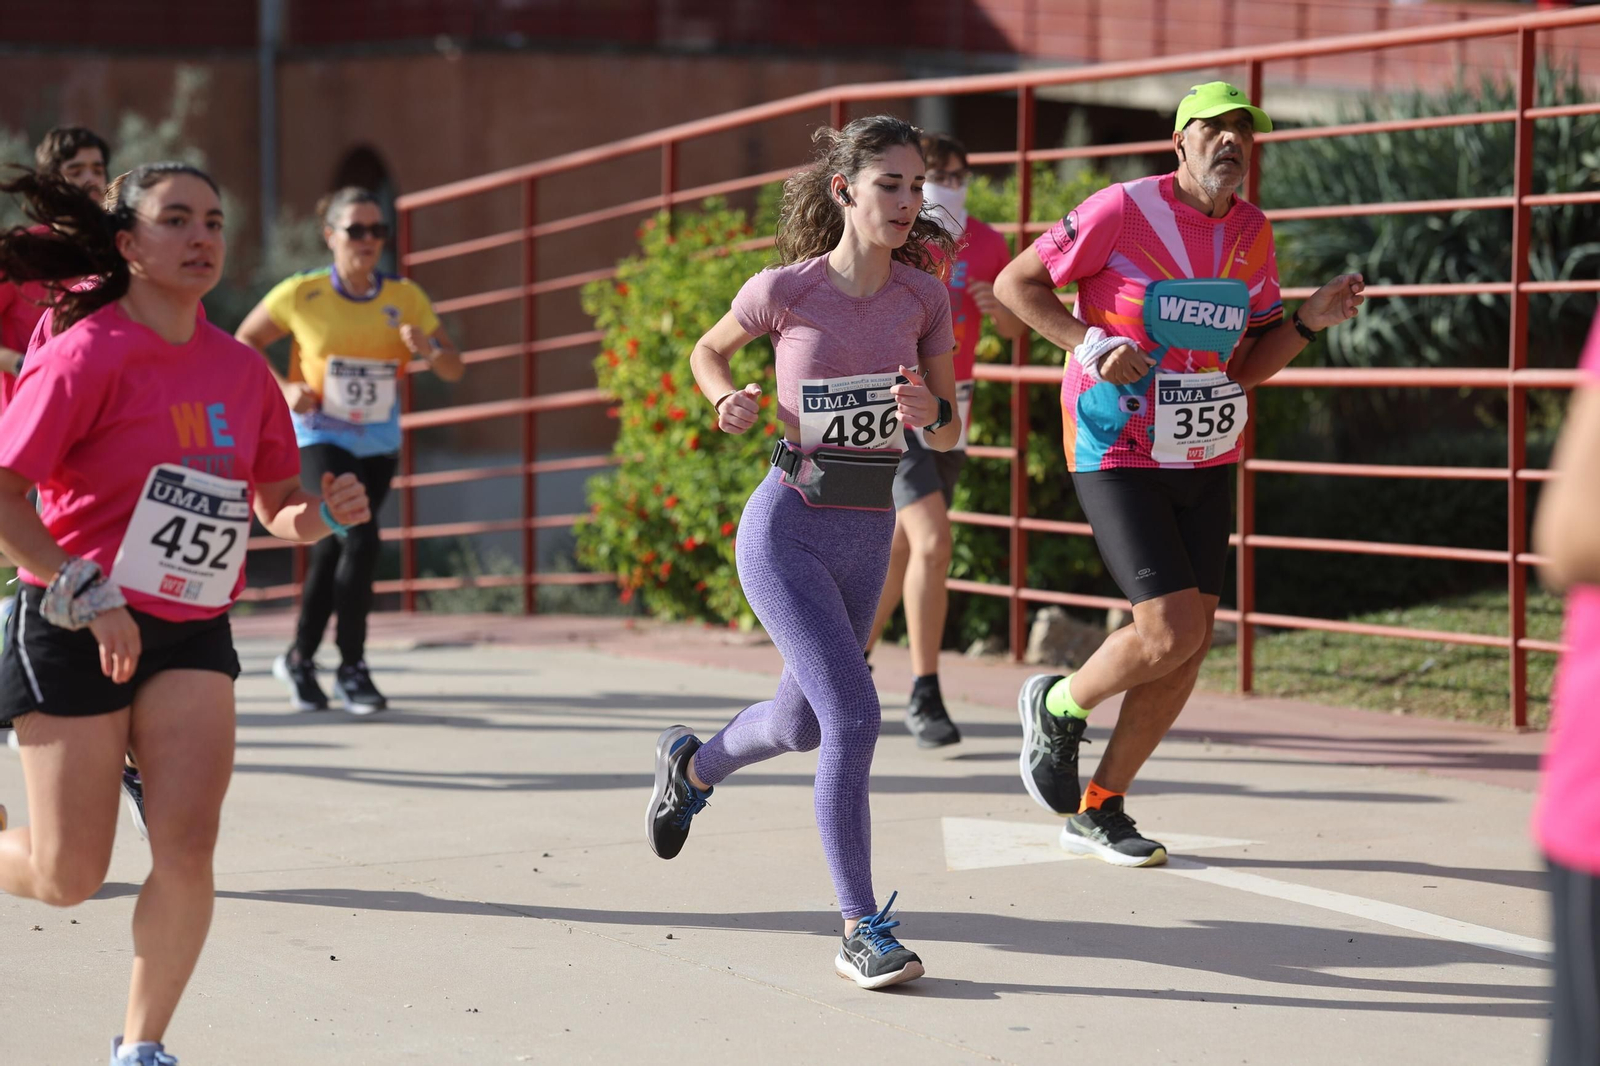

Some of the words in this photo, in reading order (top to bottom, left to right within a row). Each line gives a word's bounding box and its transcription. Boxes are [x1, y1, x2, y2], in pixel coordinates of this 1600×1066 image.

[1158, 295, 1246, 331] WERUN
[346, 381, 378, 406] 93
[806, 393, 860, 410] UMA
[1161, 390, 1205, 402] UMA
[169, 402, 235, 449] WE
[821, 405, 898, 447] 486
[1174, 403, 1235, 439] 358
[152, 481, 212, 514] UMA
[151, 515, 237, 570] 452
